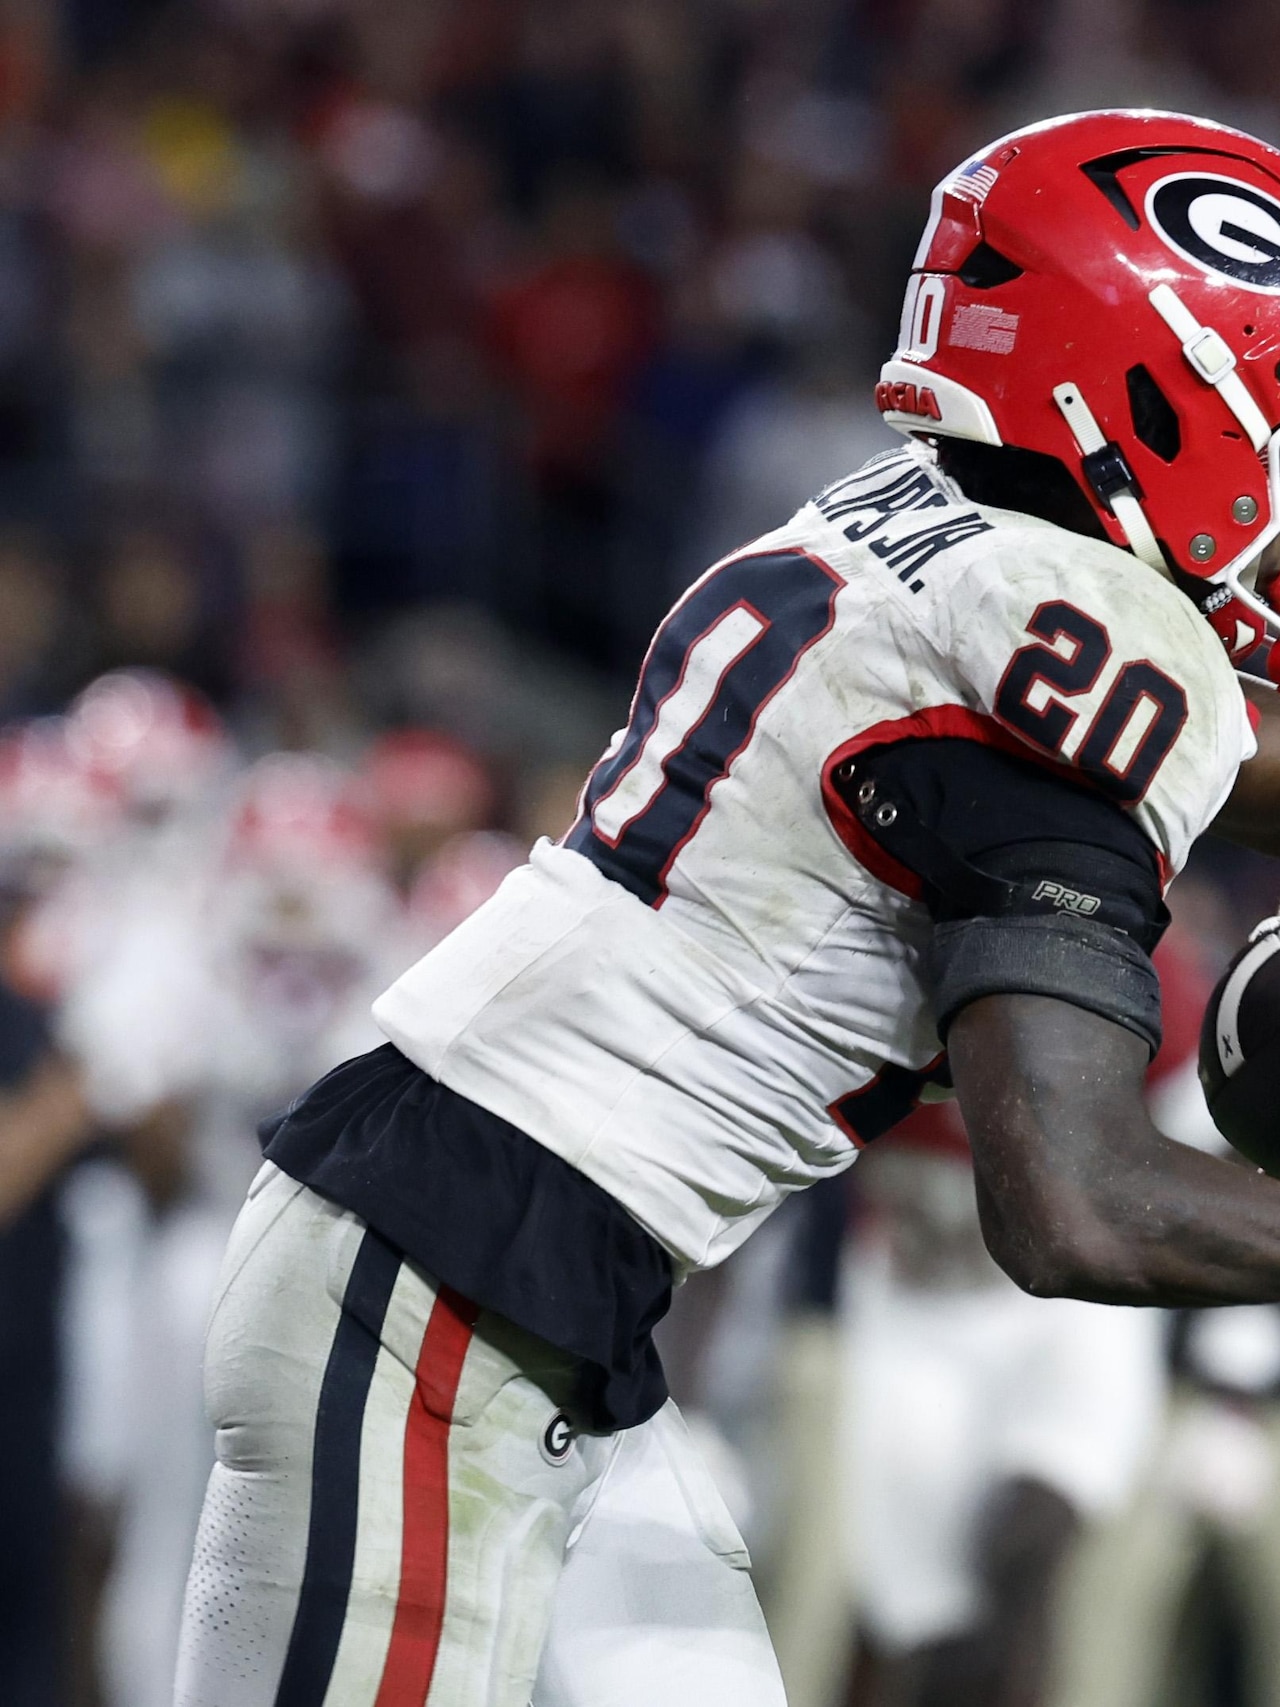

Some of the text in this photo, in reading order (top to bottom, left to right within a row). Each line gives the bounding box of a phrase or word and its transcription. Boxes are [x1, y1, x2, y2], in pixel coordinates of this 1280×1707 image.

[868, 512, 996, 594] JR.
[994, 599, 1189, 808] 20
[1031, 880, 1101, 915] PRO
